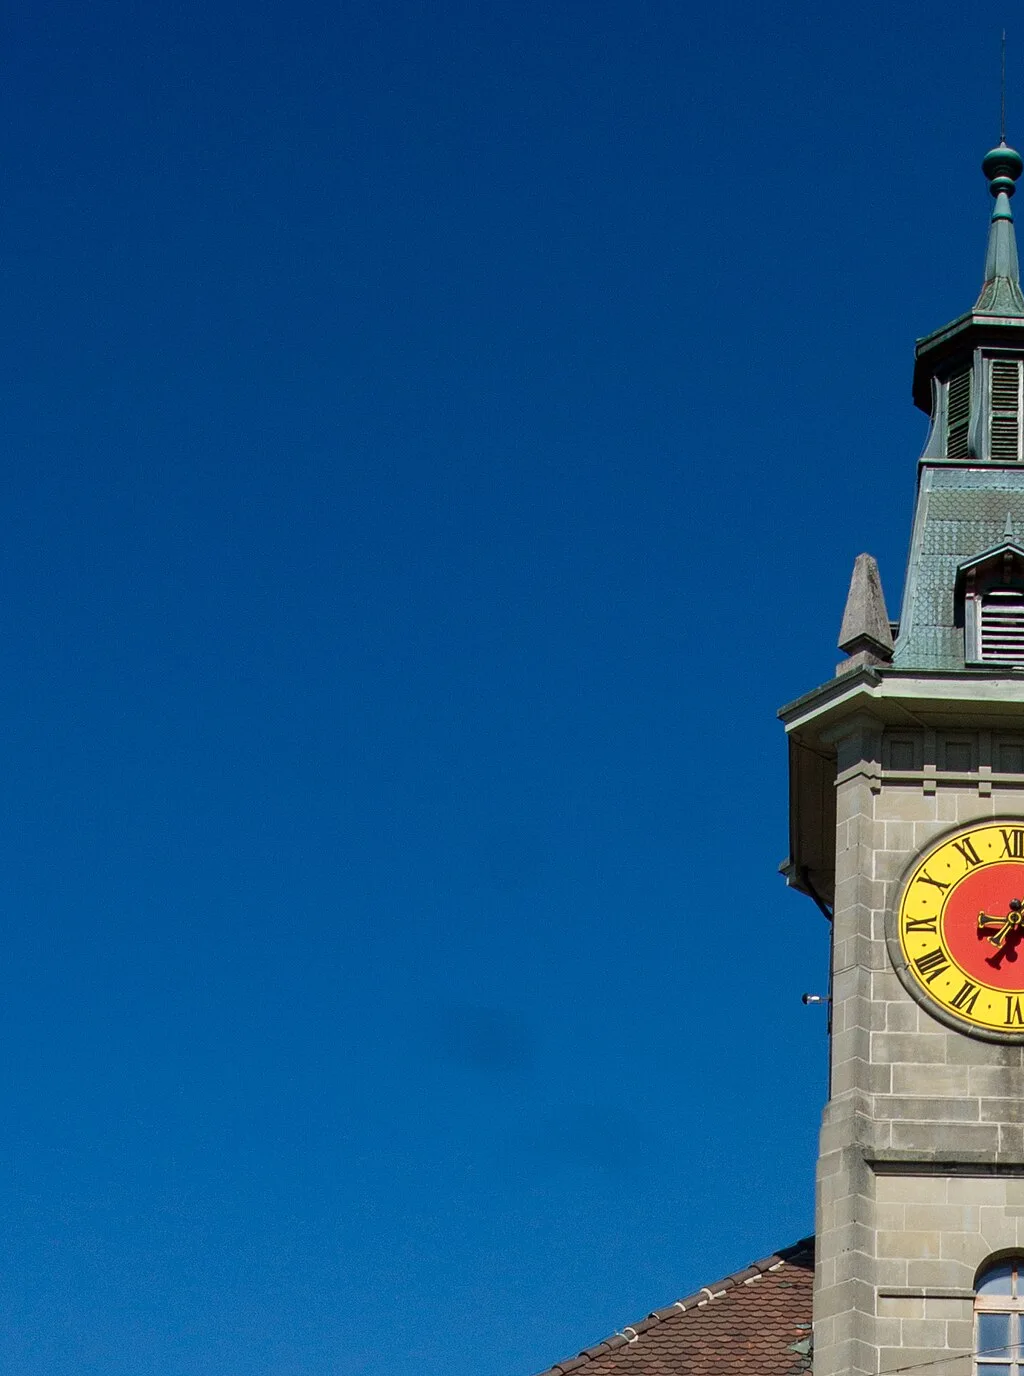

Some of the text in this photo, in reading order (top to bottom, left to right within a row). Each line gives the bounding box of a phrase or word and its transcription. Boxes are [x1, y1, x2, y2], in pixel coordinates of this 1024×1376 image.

[952, 837, 983, 870] XI
[916, 868, 951, 895] X
[905, 914, 938, 935] IX
